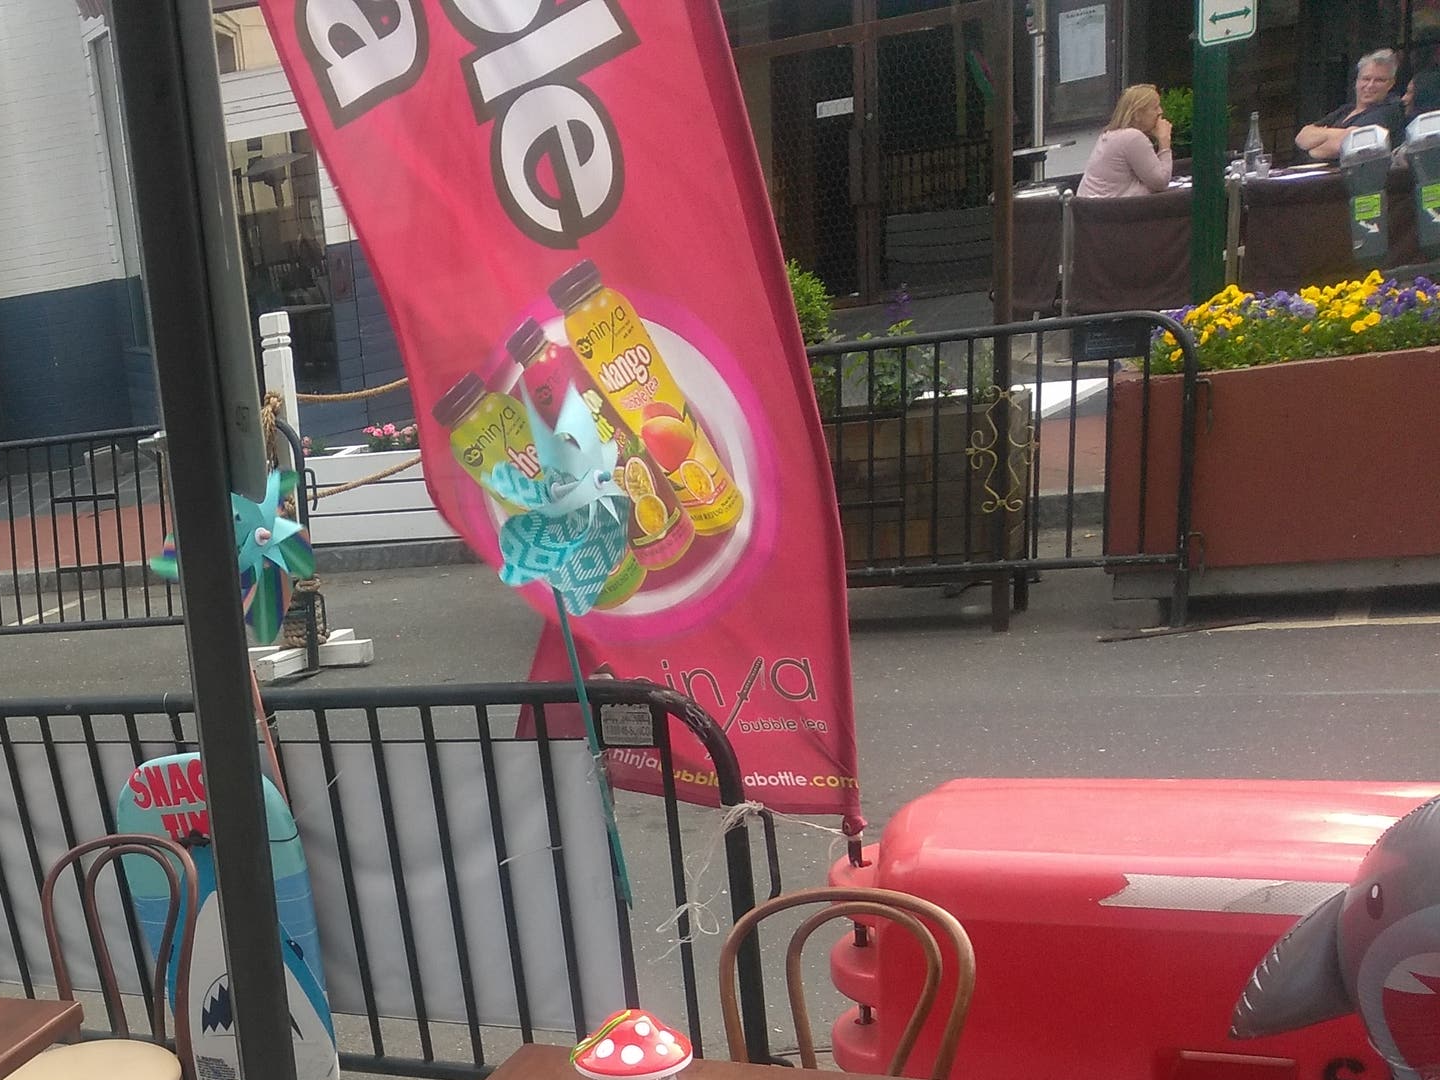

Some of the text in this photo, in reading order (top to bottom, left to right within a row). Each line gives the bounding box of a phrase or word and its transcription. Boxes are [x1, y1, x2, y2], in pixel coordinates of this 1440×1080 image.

[599, 344, 652, 393] Mango
[738, 716, 829, 733] bubble tea
[129, 759, 207, 810] SNAC
